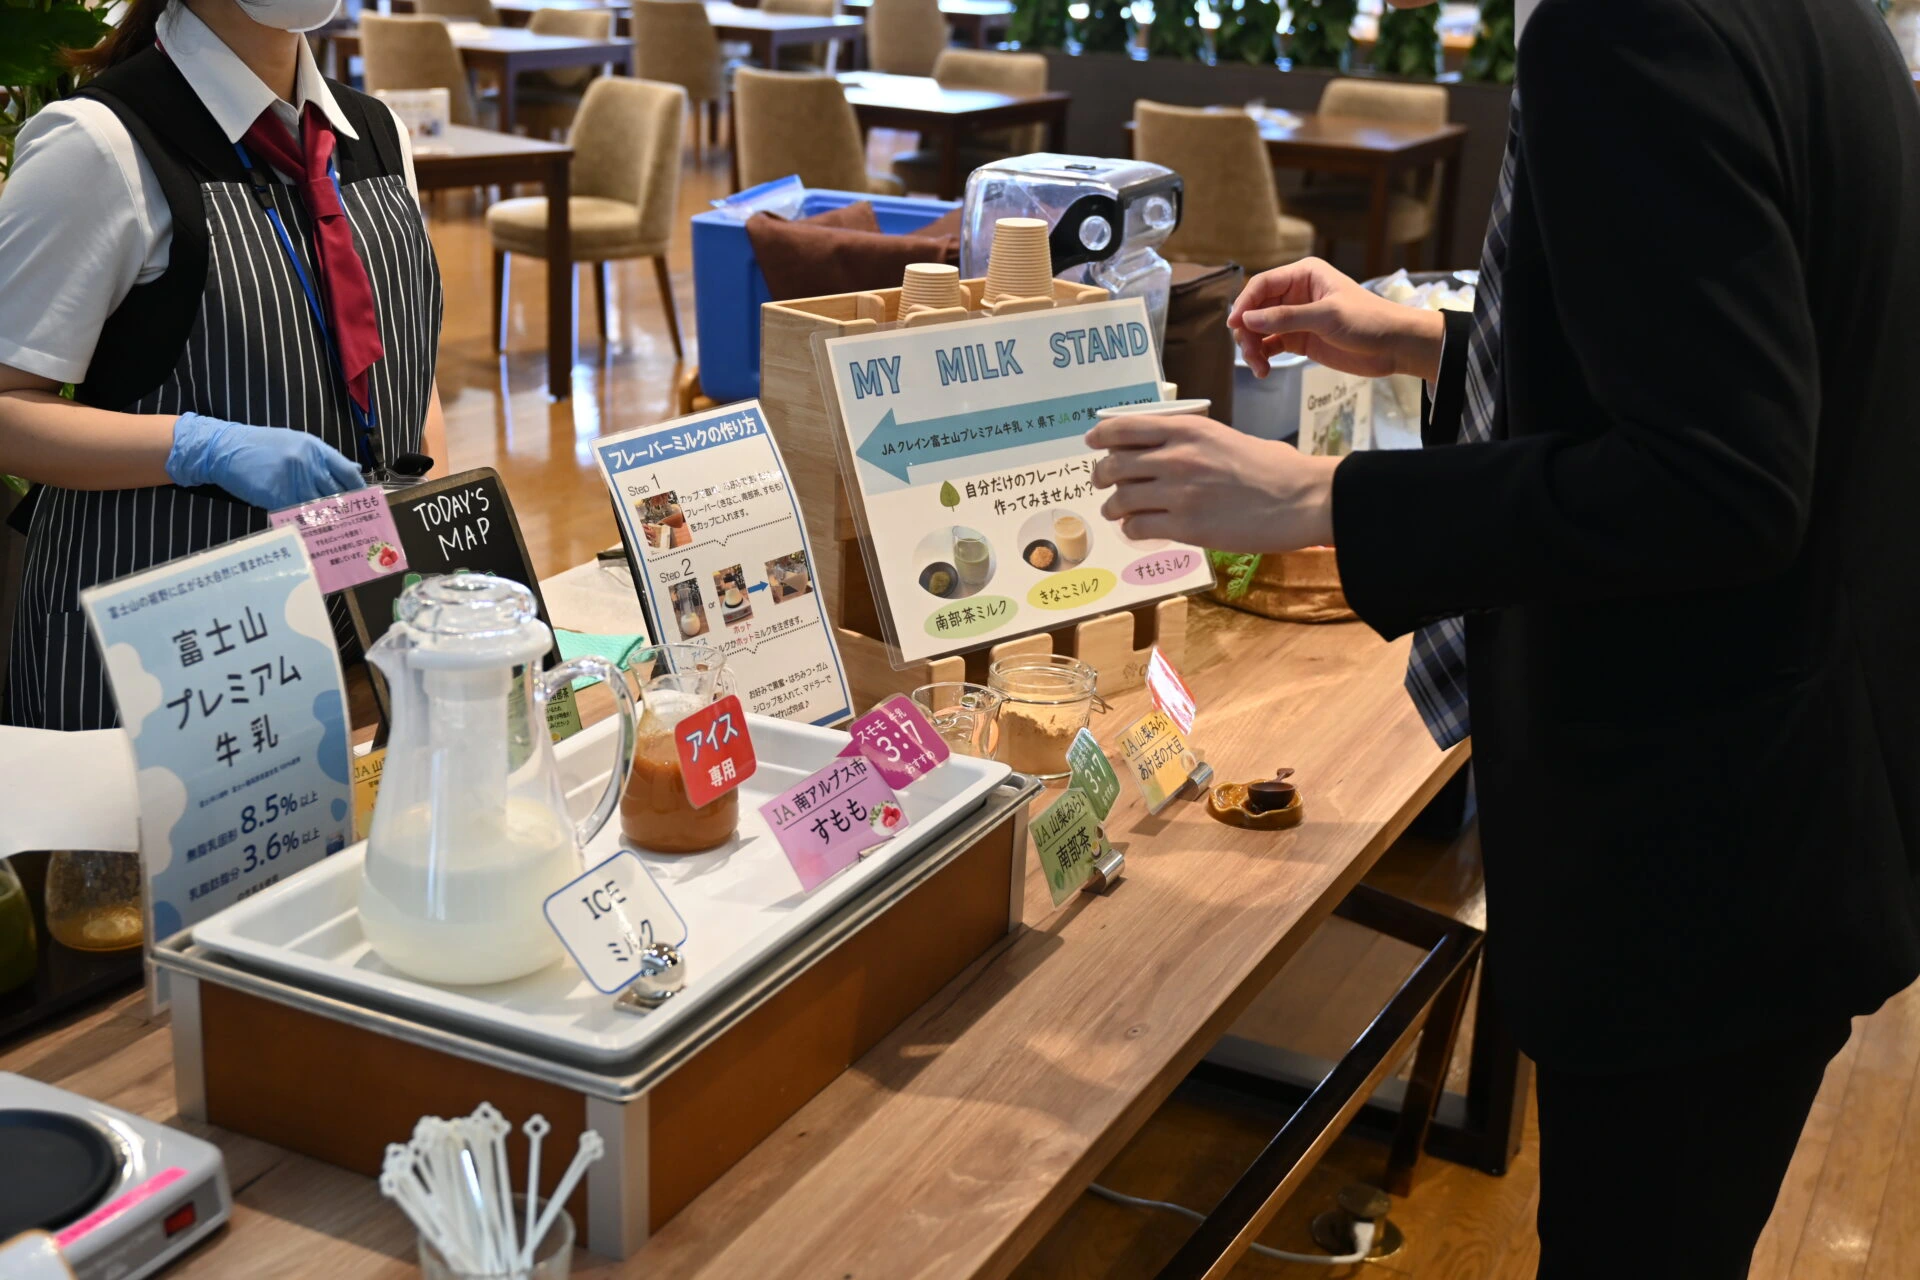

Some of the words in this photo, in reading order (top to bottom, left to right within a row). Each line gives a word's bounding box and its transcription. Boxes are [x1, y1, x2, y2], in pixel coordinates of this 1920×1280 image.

[849, 355, 901, 399] MY
[935, 339, 1023, 386] MILK
[1049, 321, 1149, 368] STAND
[1308, 393, 1332, 410] Green
[608, 414, 759, 471] フレーバーミルクの作り方
[627, 484, 650, 497] Step
[651, 473, 661, 489] 1
[993, 480, 1094, 516] 作ってみませんか？
[412, 487, 490, 532] TODAY'S
[690, 508, 749, 533] をカップに入れます。
[438, 517, 490, 561] MAP
[659, 569, 681, 584] Step
[681, 558, 694, 576] 2
[1134, 554, 1191, 580] すももミルク
[1038, 578, 1100, 605] きなこミルク
[172, 605, 268, 668] 富士山
[935, 599, 1007, 632] 南部茶ミルク
[166, 655, 302, 730] プレミアム
[215, 713, 279, 768] 牛乳
[686, 713, 739, 763] アイス
[856, 719, 888, 745] スモモ
[876, 719, 923, 762] 3:7
[708, 757, 737, 787] 専用
[904, 751, 936, 775] おすすめ
[1084, 753, 1107, 794] 3:7
[1137, 735, 1185, 781] あけぼの大豆
[241, 793, 298, 834] 8.5%
[300, 790, 319, 807] 以上
[772, 804, 796, 826] JA
[810, 798, 868, 845] すもも
[243, 831, 299, 873] 3.6%
[302, 827, 320, 844] 以上
[1055, 825, 1092, 872] 南部茶
[581, 880, 627, 920] ICE
